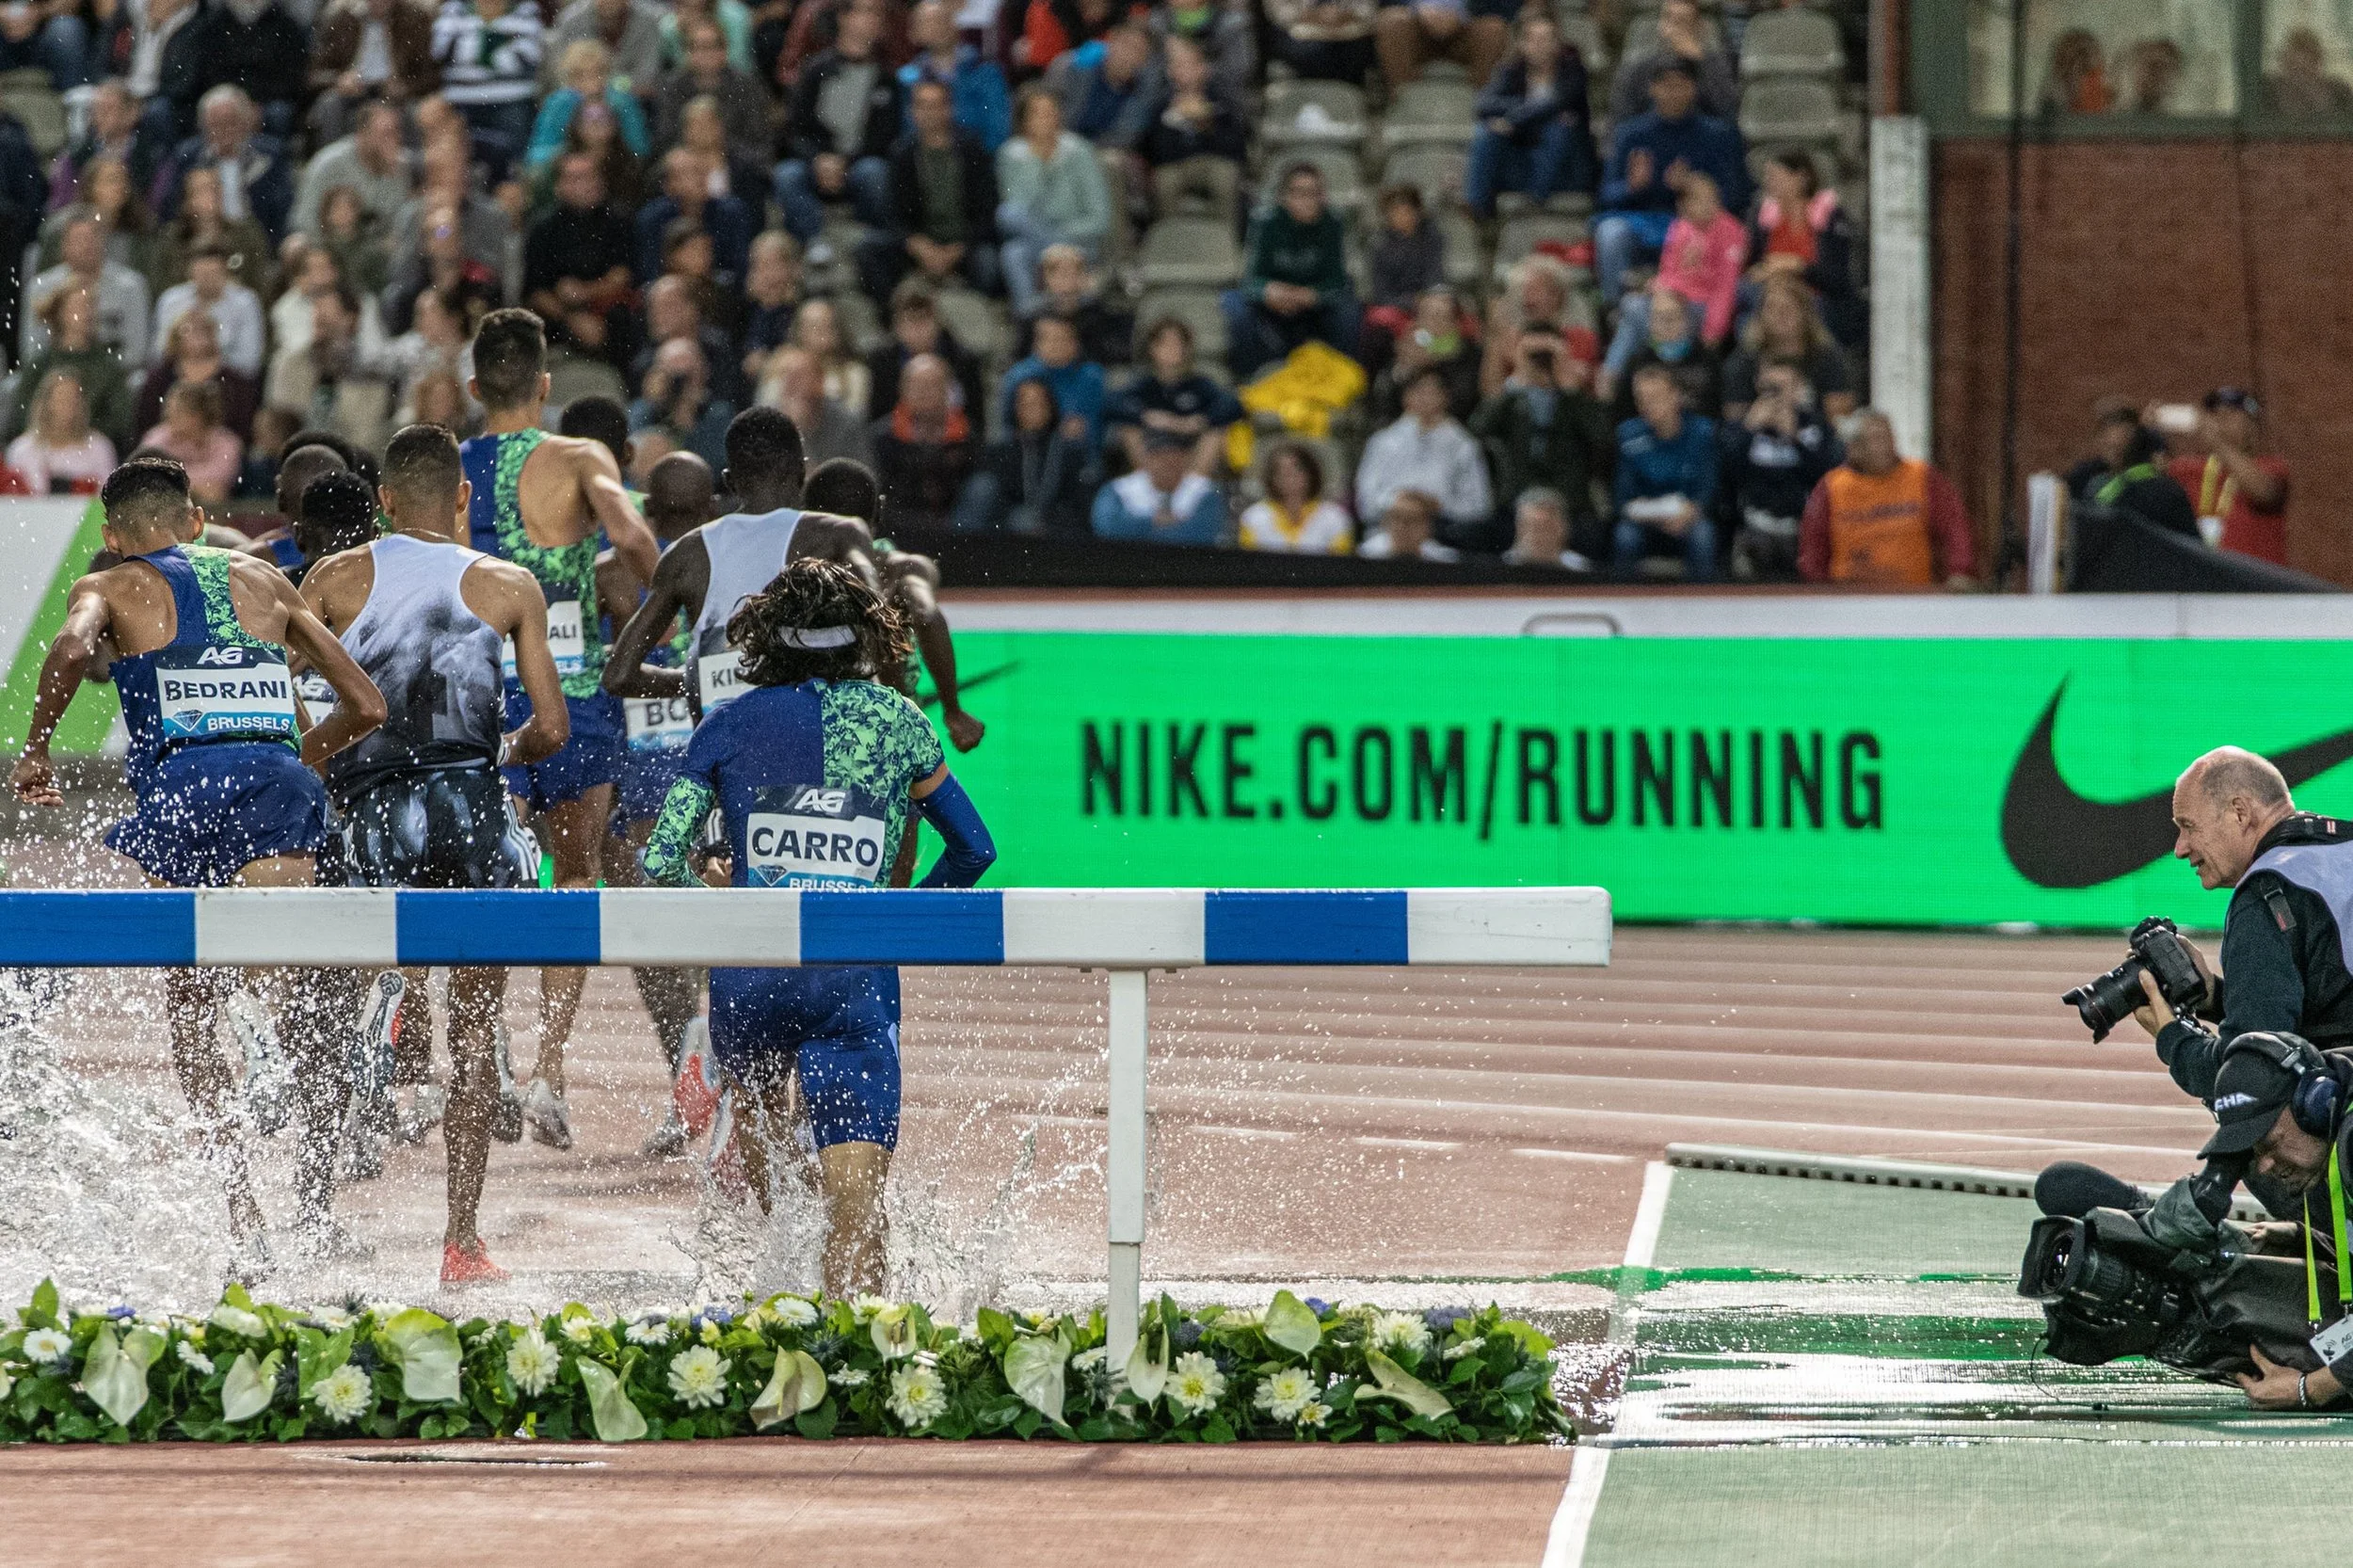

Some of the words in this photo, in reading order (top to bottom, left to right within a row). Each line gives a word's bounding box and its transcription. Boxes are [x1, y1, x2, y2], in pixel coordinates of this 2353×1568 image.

[549, 624, 577, 639] ALI
[197, 647, 244, 665] AG
[164, 680, 288, 702] BEDRANI
[207, 716, 291, 731] BRUSSELS
[1080, 719, 1883, 841] NIKE.COM/RUNNING
[793, 788, 846, 813] AG
[751, 826, 879, 868] CARRO
